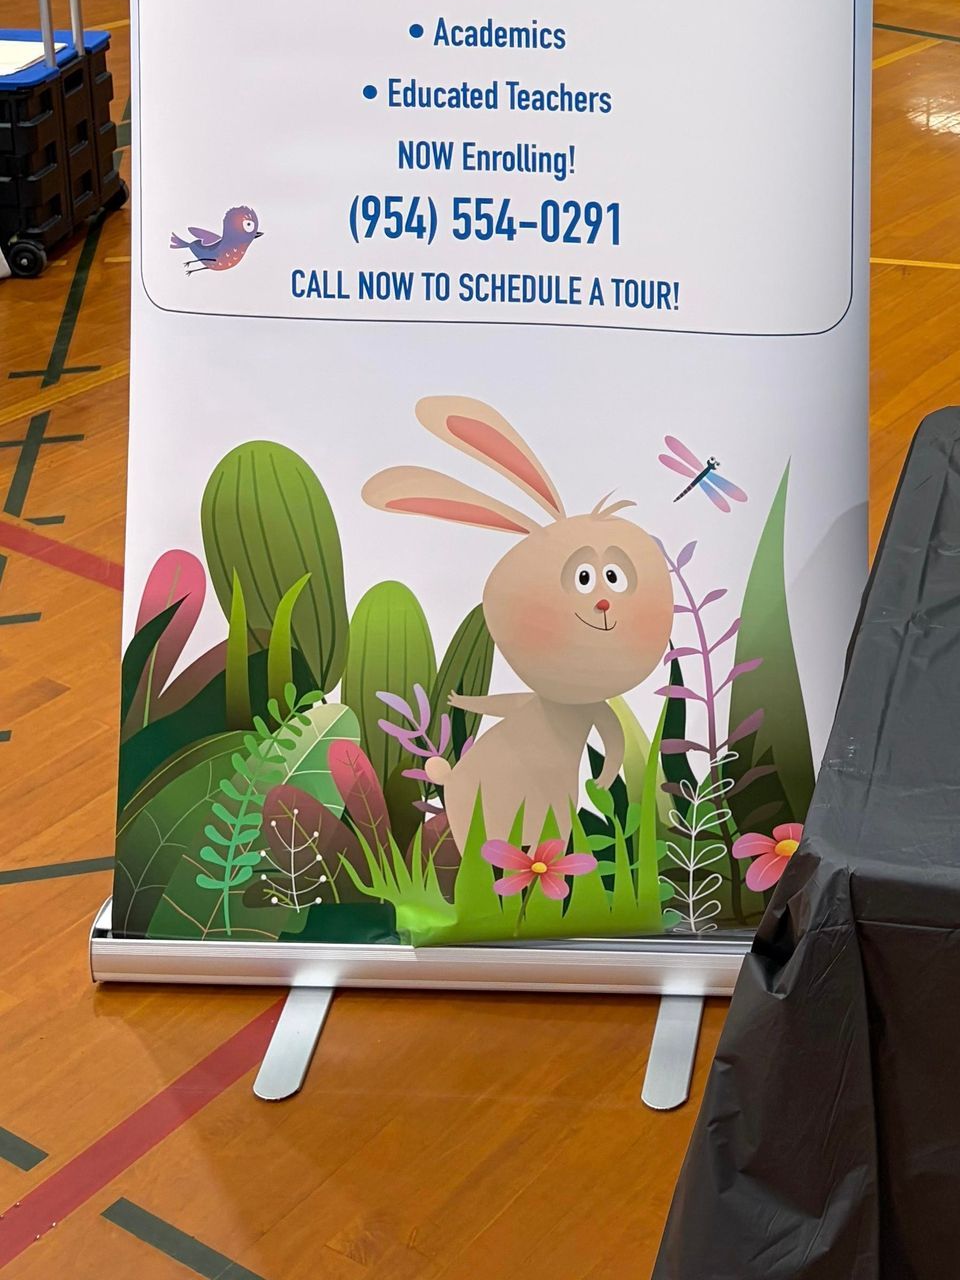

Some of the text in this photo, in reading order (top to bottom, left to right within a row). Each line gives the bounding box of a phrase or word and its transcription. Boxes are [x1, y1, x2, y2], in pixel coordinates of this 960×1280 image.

[434, 18, 566, 50] Academics
[388, 79, 612, 114] Educated Teachers
[398, 140, 575, 181] NOW Enrolling!
[349, 195, 622, 246] (954) 554-0291
[290, 270, 680, 311] CALL NOW TO SCHEDULE A TOUR!
